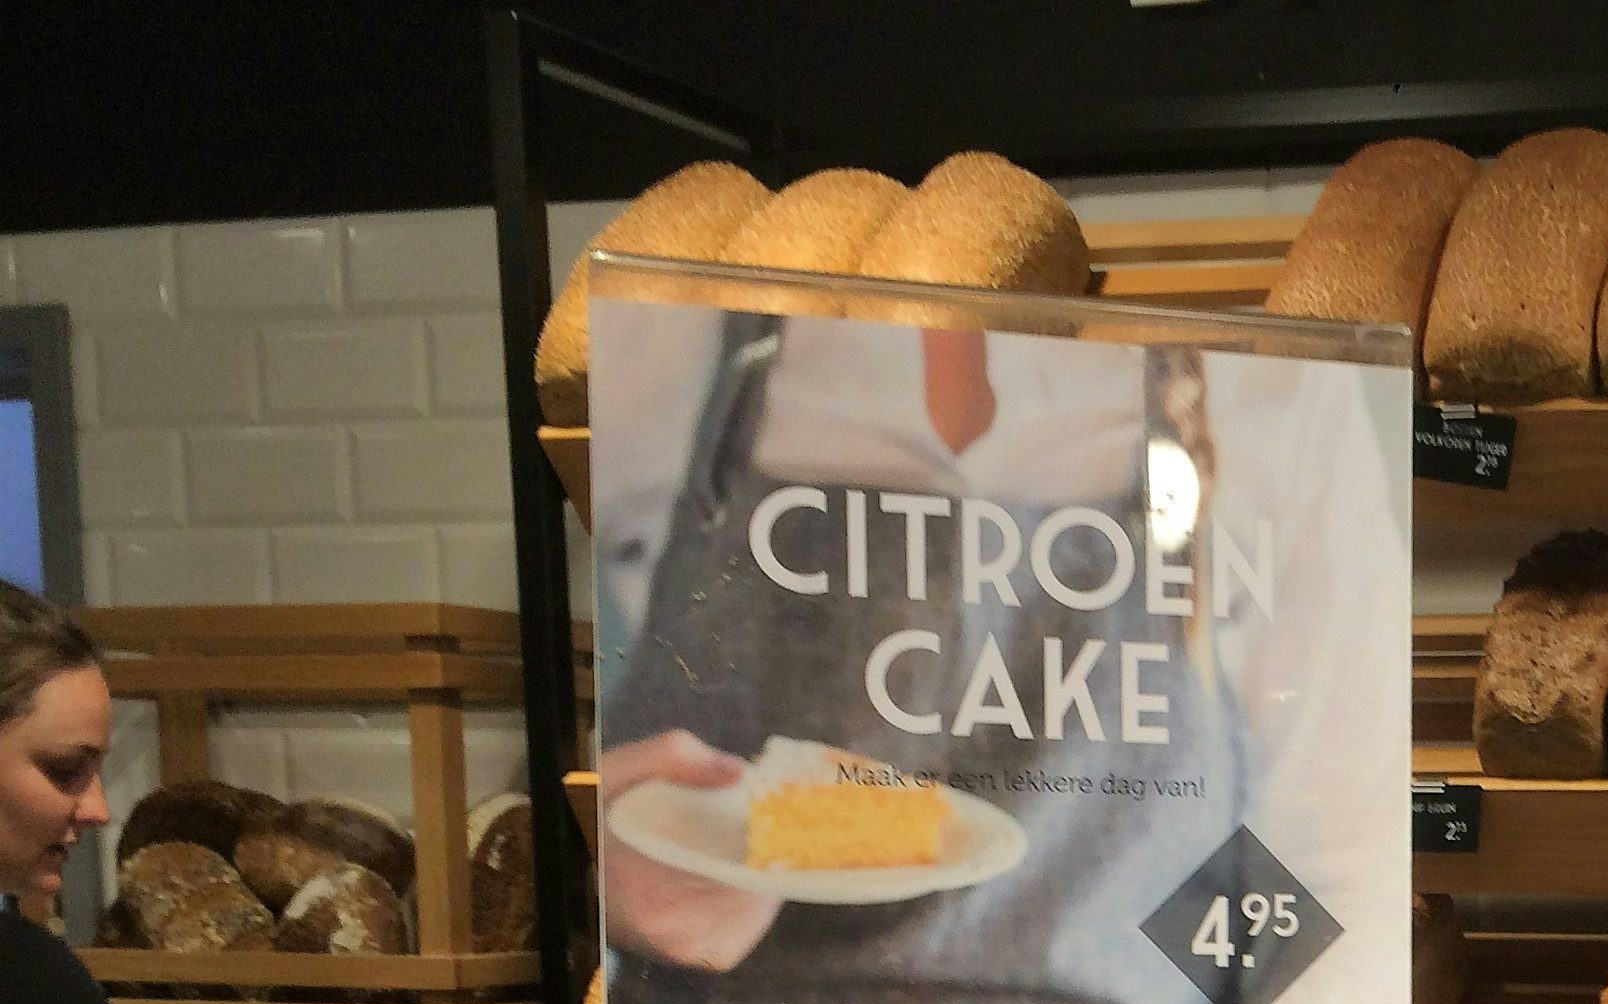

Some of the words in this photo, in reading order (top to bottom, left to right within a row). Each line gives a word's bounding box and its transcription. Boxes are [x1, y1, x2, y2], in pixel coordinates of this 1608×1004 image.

[748, 485, 1275, 624] CITROEN
[864, 629, 1171, 744] CAKE
[836, 762, 907, 788] Maak
[914, 770, 940, 788] er
[947, 771, 998, 790] een
[1002, 769, 1094, 794] lekkere
[1100, 772, 1148, 801] dag
[1152, 776, 1206, 798] van!
[1190, 892, 1300, 969] 4.95
